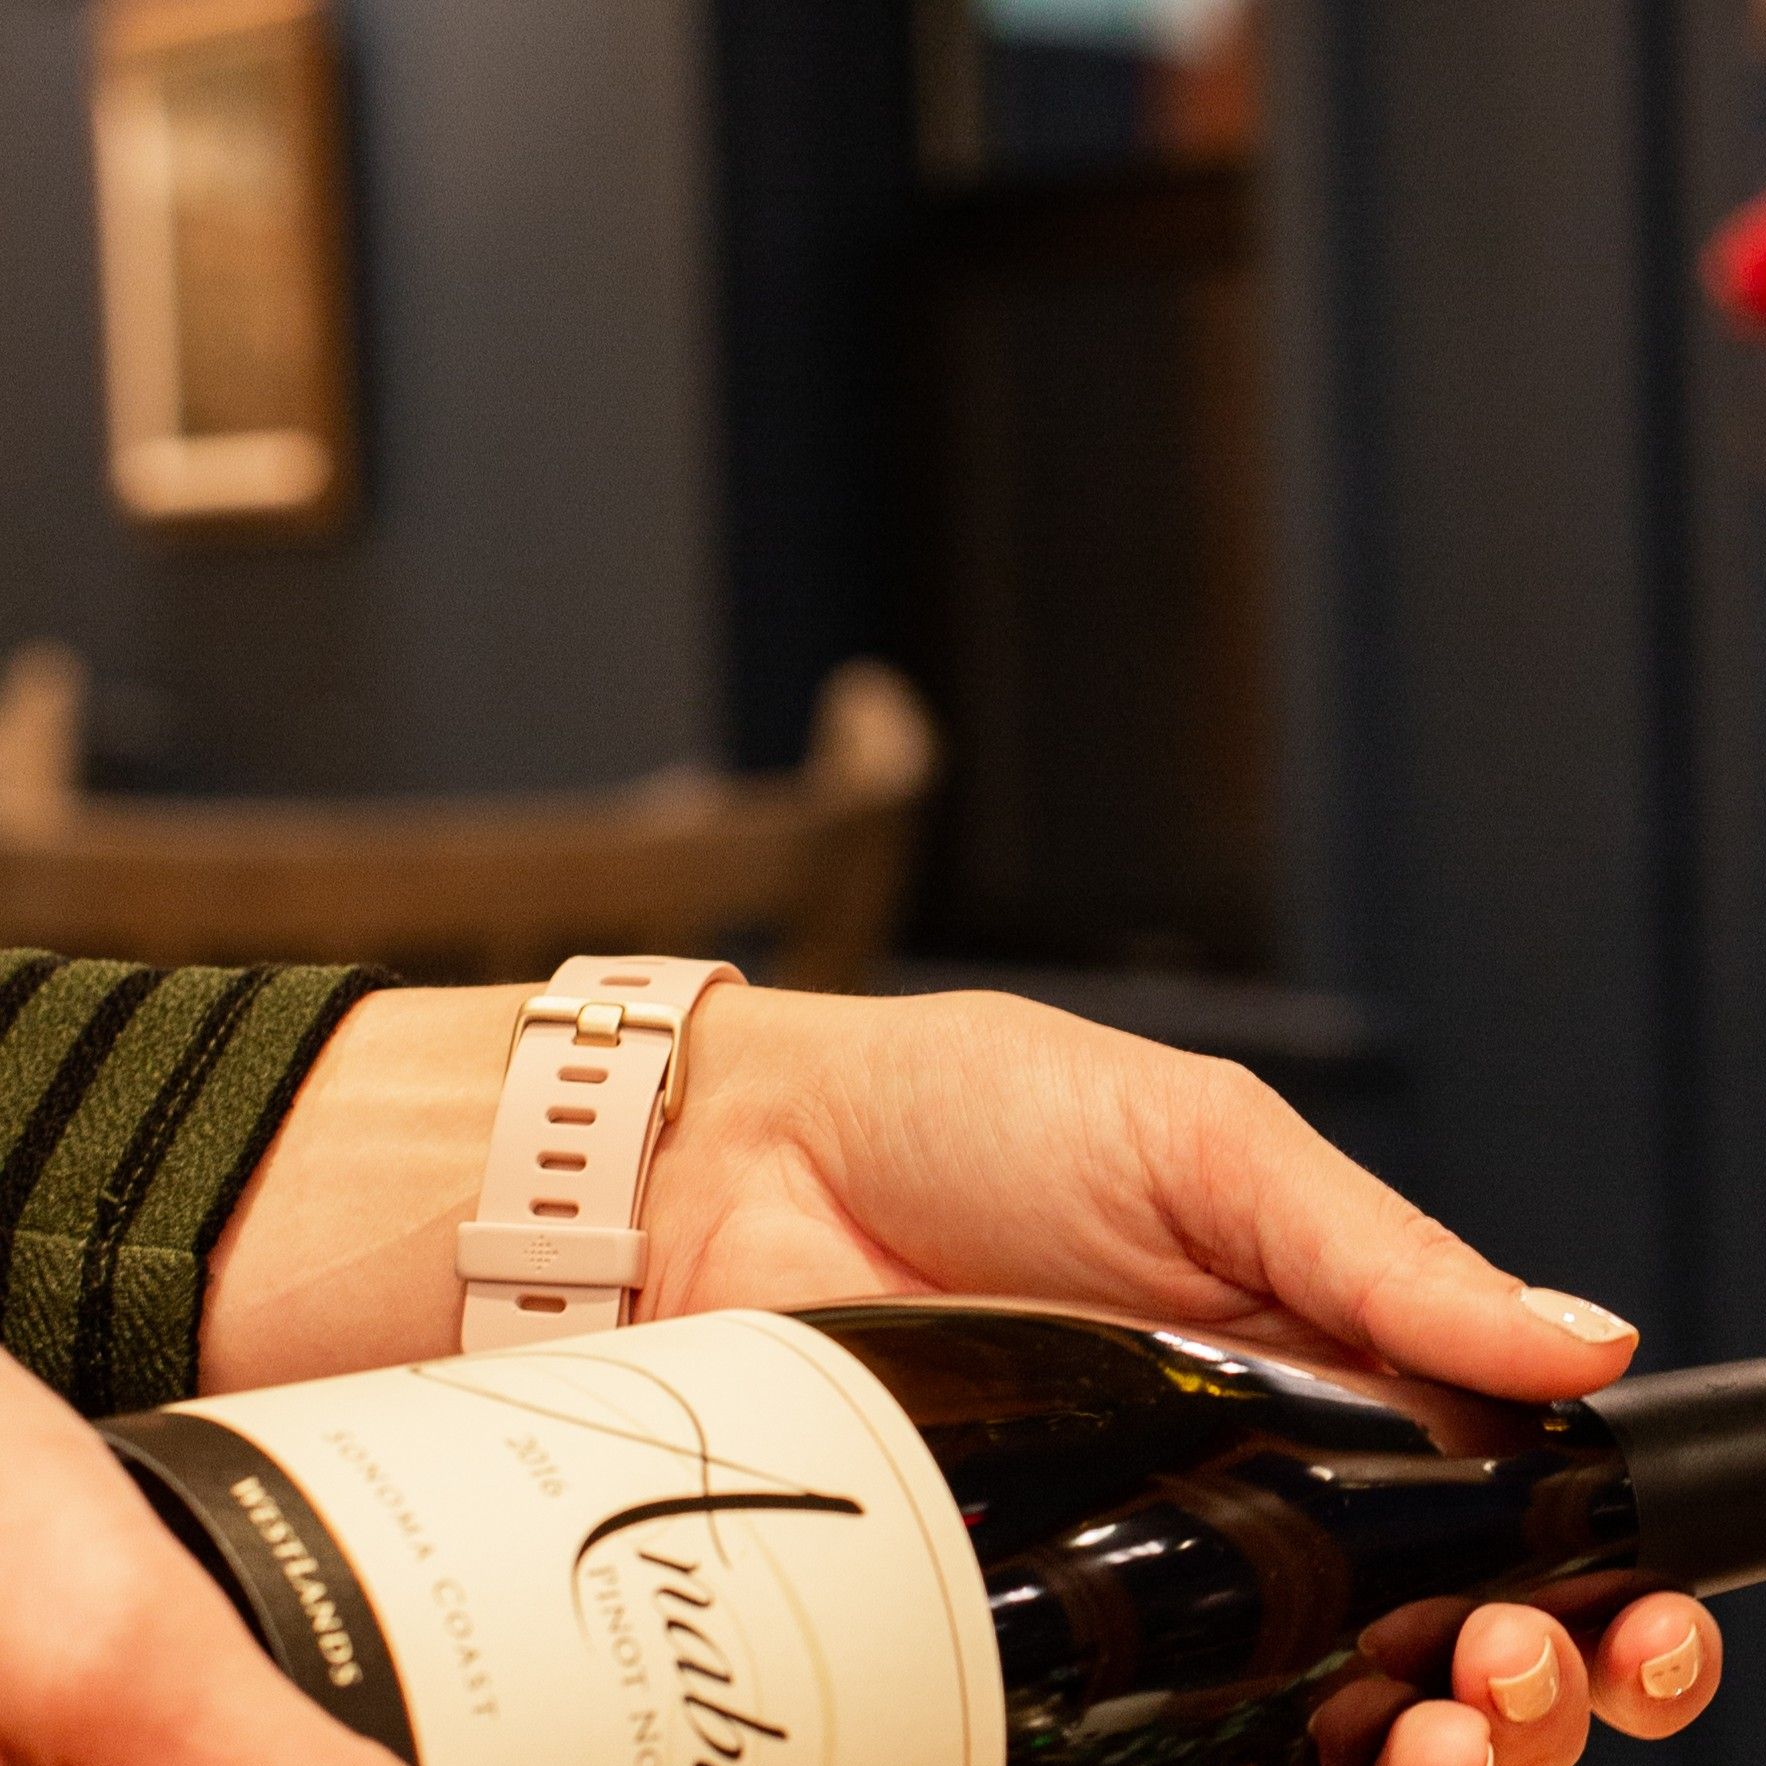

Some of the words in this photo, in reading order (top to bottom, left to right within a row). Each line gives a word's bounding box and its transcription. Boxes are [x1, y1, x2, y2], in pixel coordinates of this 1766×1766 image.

[504, 1433, 569, 1499] 2016
[229, 1474, 363, 1688] WESTLANDS
[322, 1429, 434, 1562] SONOMA
[431, 1577, 501, 1721] COAST
[588, 1563, 649, 1690] PINOT
